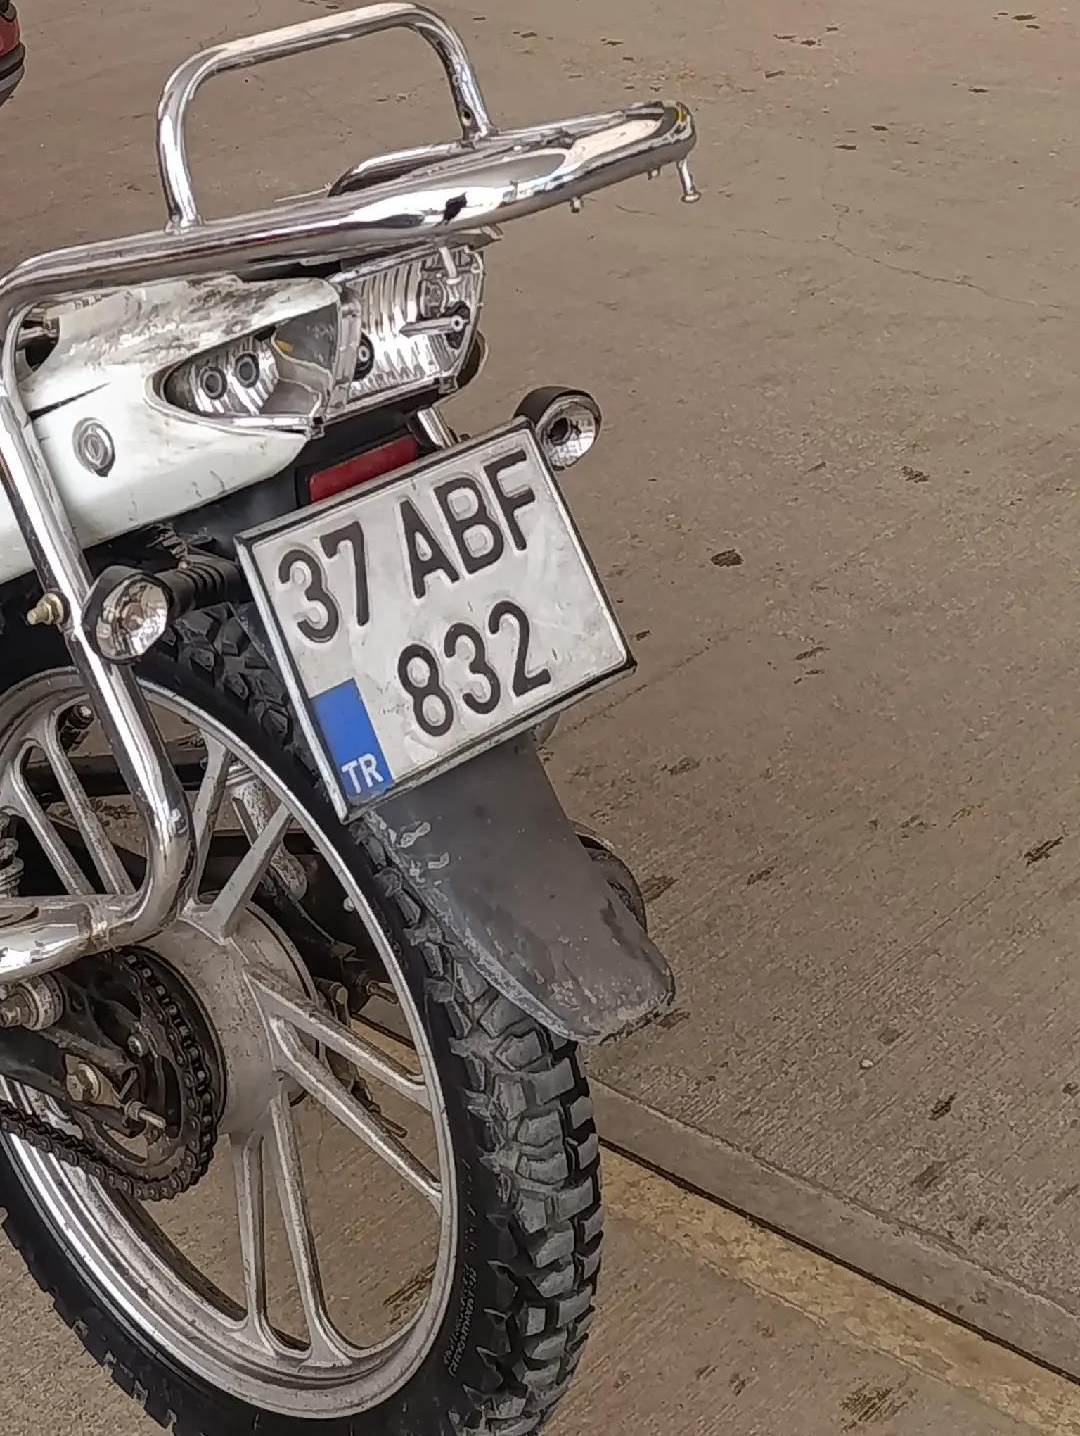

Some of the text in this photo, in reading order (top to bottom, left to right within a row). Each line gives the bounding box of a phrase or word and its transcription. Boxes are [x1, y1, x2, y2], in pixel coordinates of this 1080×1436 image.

[277, 449, 536, 644] 37 ABF
[396, 600, 552, 738] 832
[341, 753, 385, 795] TR
